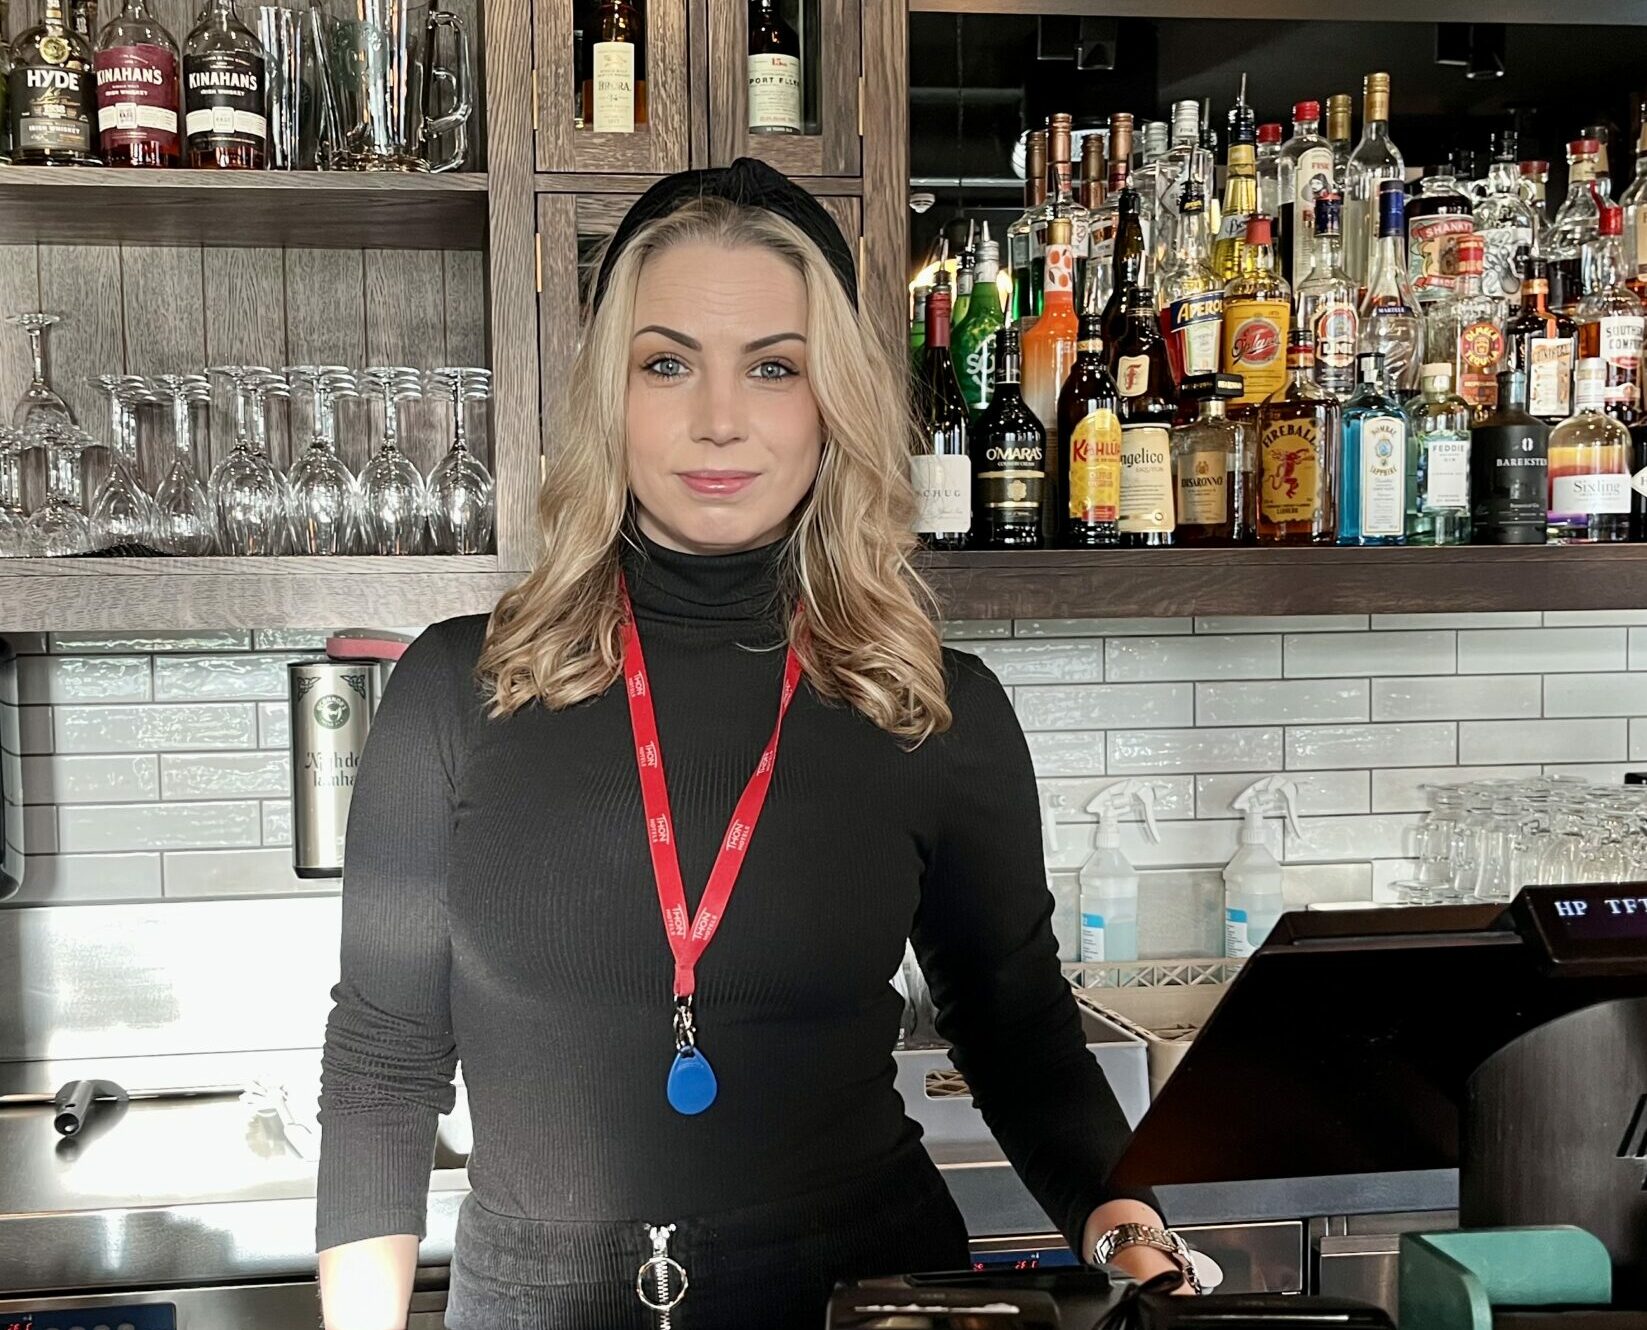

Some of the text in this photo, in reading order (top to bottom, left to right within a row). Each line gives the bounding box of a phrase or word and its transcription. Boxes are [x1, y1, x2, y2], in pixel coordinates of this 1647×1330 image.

[27, 69, 80, 91] HYDE
[96, 65, 163, 86] KINAHAN'S
[188, 71, 258, 91] KINAHAN'S
[1262, 424, 1318, 449] FIREBALL
[1120, 448, 1164, 468] ngelico
[657, 813, 670, 845] THON
[726, 818, 745, 851] THON
[1554, 900, 1588, 916] HP
[672, 903, 687, 939] THON
[691, 906, 711, 942] THON
